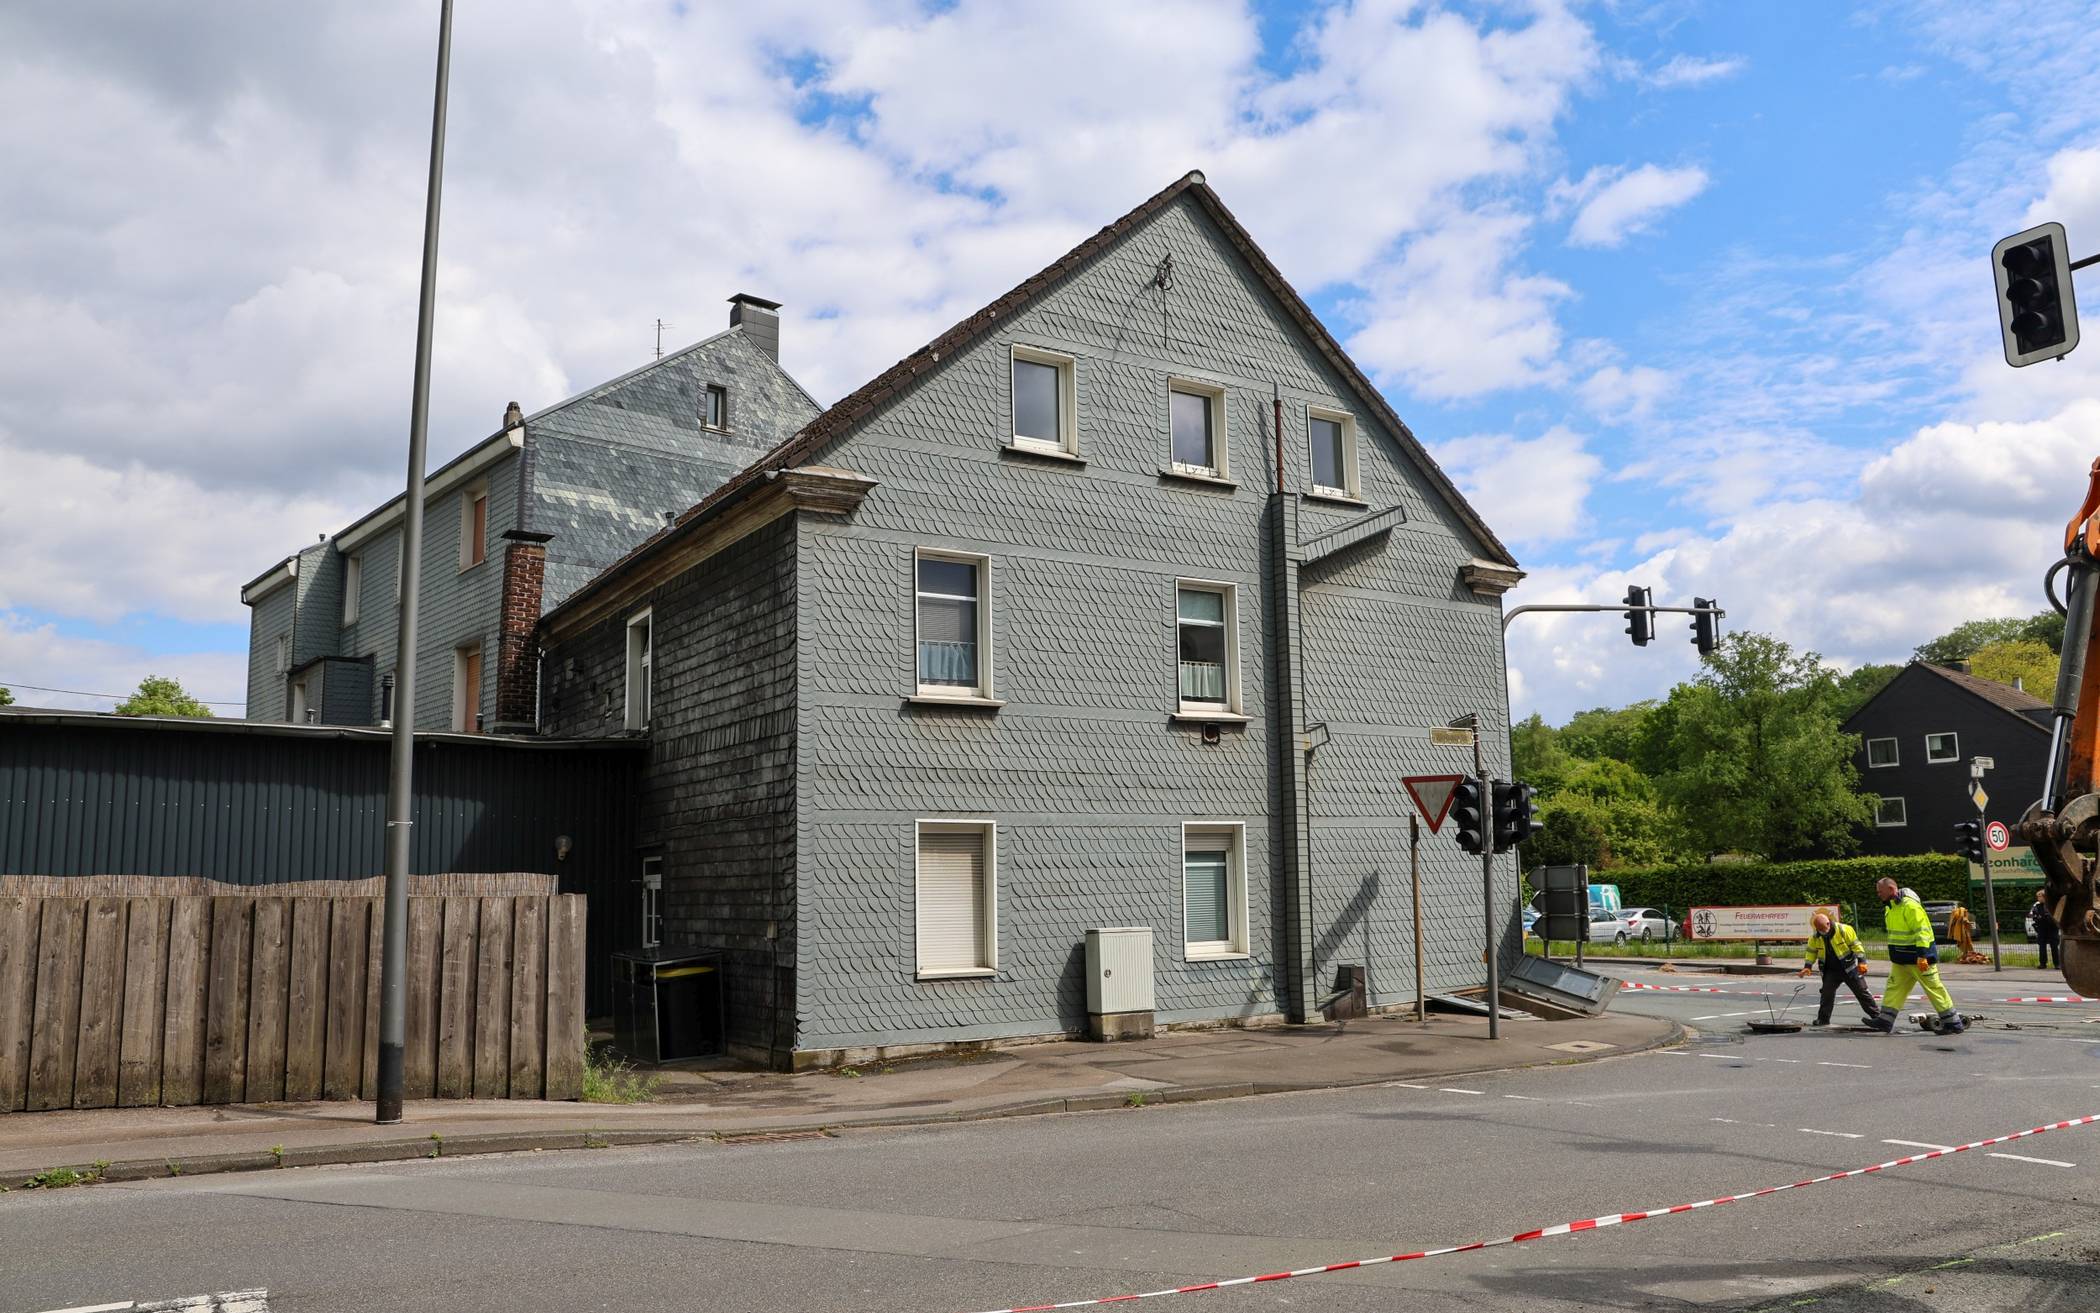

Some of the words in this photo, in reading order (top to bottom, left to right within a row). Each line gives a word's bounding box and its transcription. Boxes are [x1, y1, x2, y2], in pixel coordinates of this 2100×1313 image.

[1992, 830, 2004, 842] 50
[1979, 857, 2040, 868] eonhar
[1735, 912, 1790, 920] FEUERWEHRFEST
